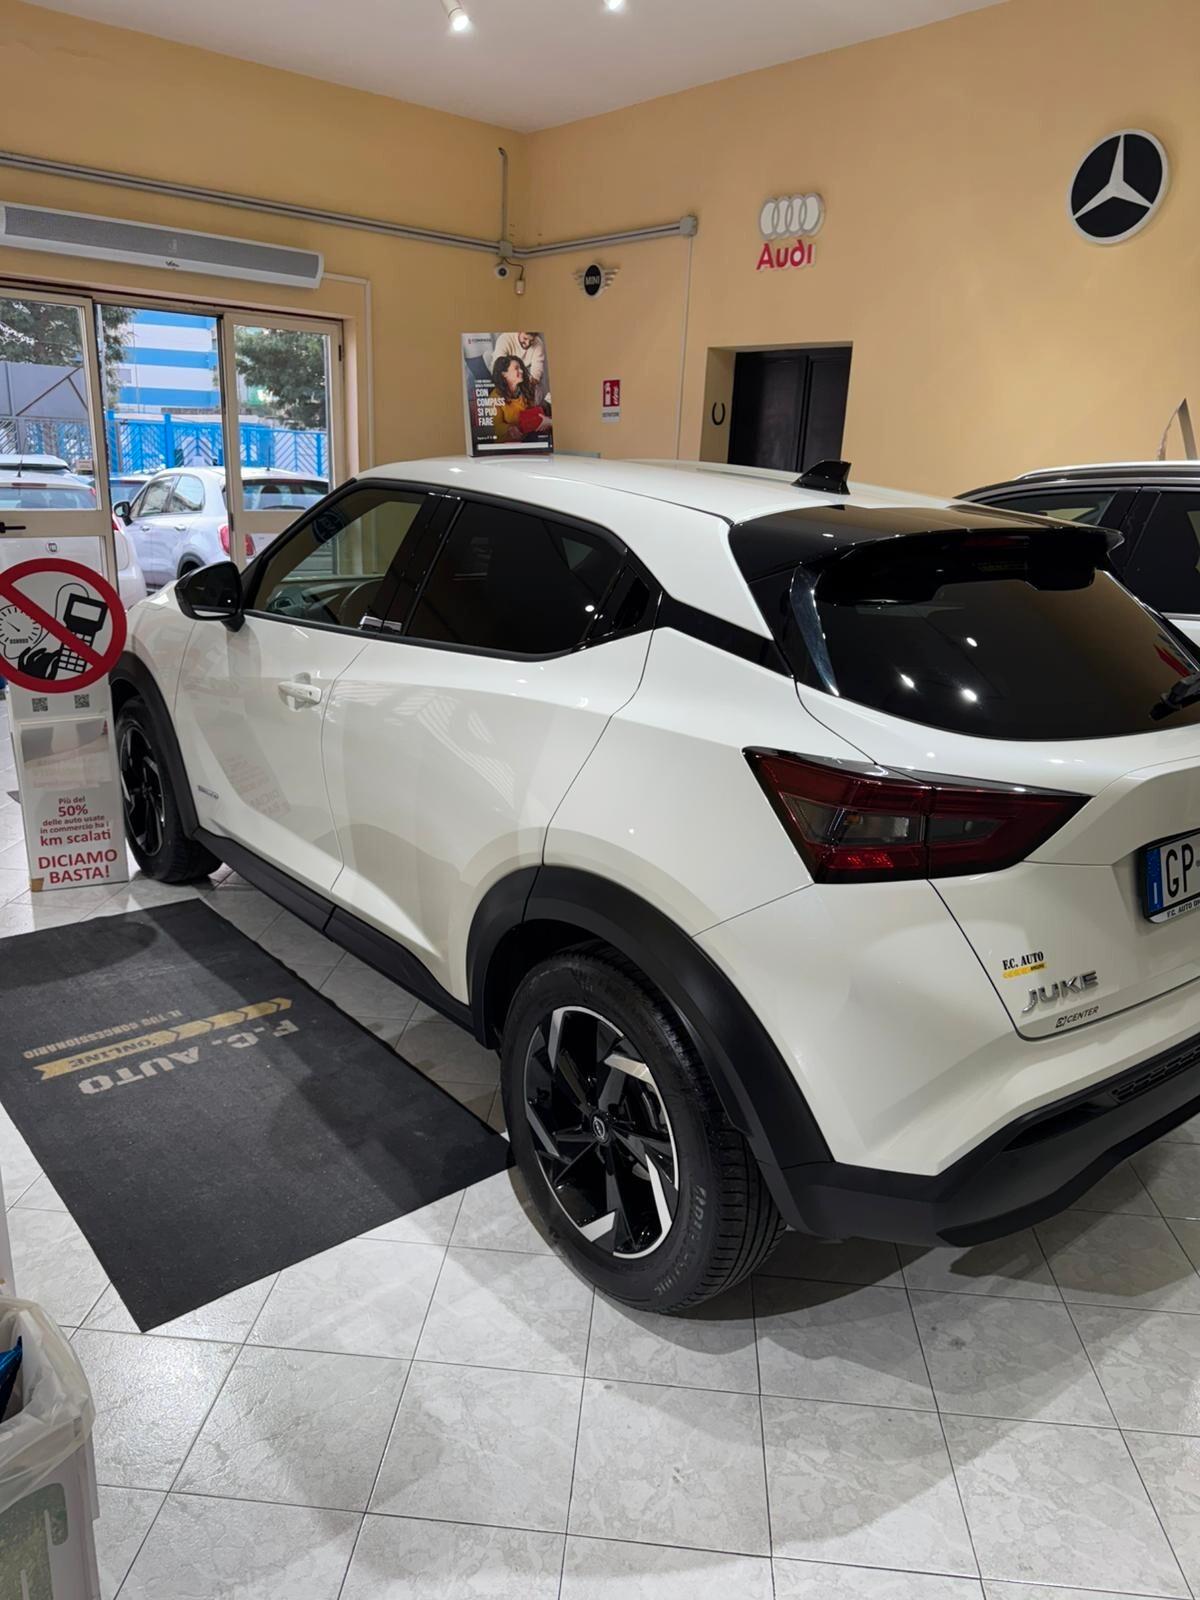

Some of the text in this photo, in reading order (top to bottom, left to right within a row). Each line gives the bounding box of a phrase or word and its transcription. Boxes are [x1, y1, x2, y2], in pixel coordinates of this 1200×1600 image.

[756, 239, 813, 271] Audi
[585, 276, 600, 286] MINI
[475, 388, 489, 397] CON
[476, 397, 506, 407] COMPASS
[477, 408, 484, 417] SI
[478, 417, 494, 426] FARE
[58, 796, 86, 805] Più del
[58, 804, 89, 817] 50%
[42, 818, 62, 827] delle
[84, 815, 105, 823] usate
[50, 823, 93, 834] commercio
[94, 821, 105, 829] ha
[40, 829, 111, 847] km scalati
[38, 848, 118, 870] DICIAMO
[49, 864, 110, 884] BASTA!
[1178, 901, 1193, 913] AUTO
[1020, 951, 1044, 967] AUTO
[1022, 970, 1099, 1014] JUKE
[77, 1045, 199, 1096] AUTO
